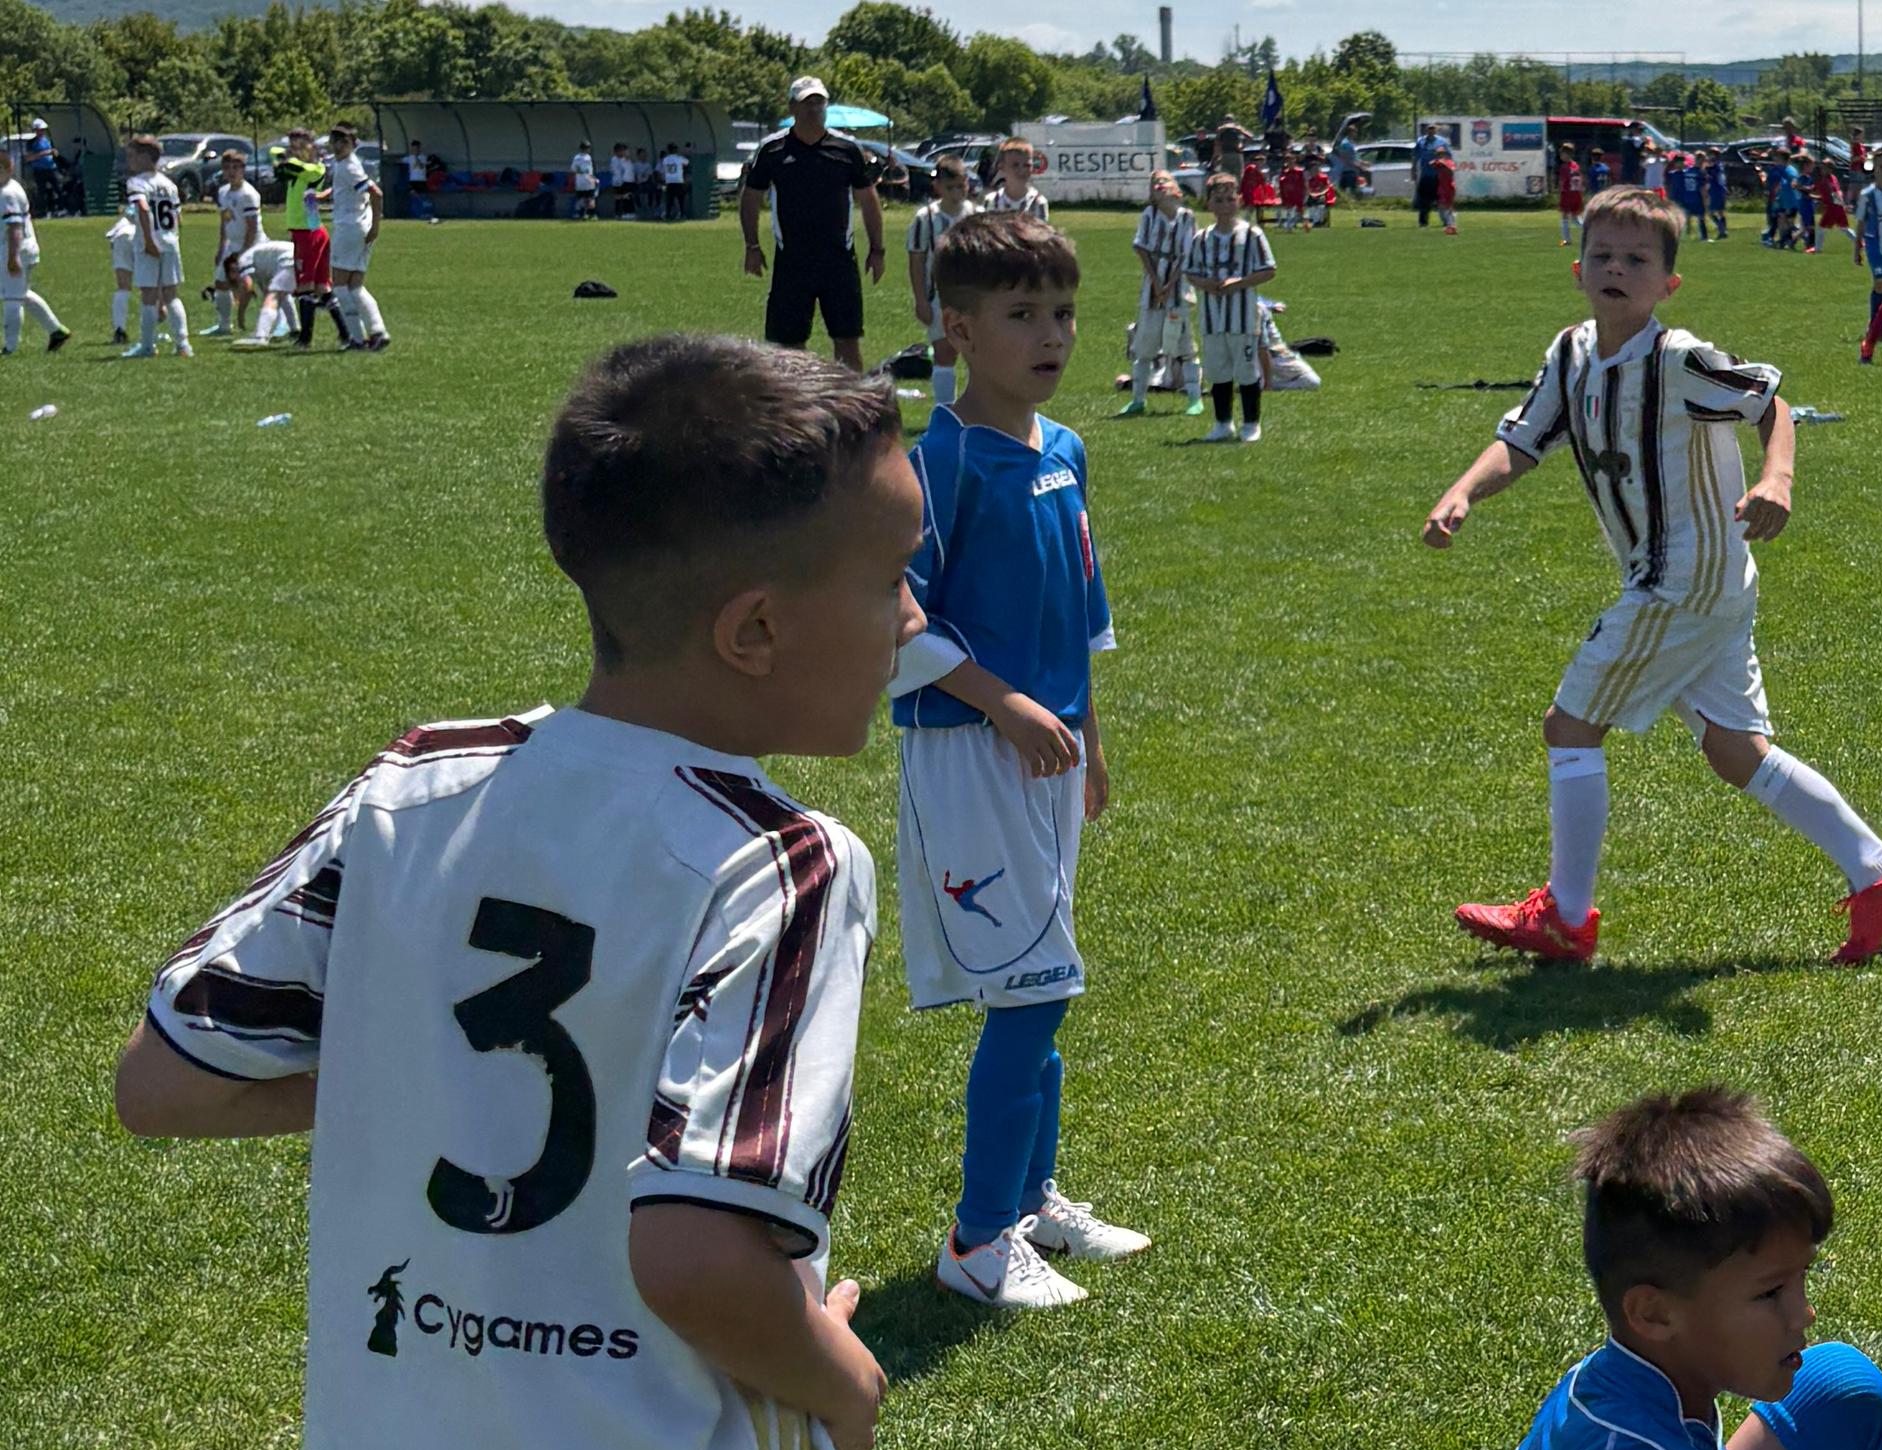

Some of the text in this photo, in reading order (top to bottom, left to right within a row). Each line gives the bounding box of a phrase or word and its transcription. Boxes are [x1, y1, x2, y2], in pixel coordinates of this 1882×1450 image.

[1058, 152, 1158, 173] RESPECT
[150, 199, 175, 231] 16
[1004, 963, 1080, 991] LEGEA
[427, 896, 597, 1235] 3
[414, 1292, 640, 1360] Cygames
